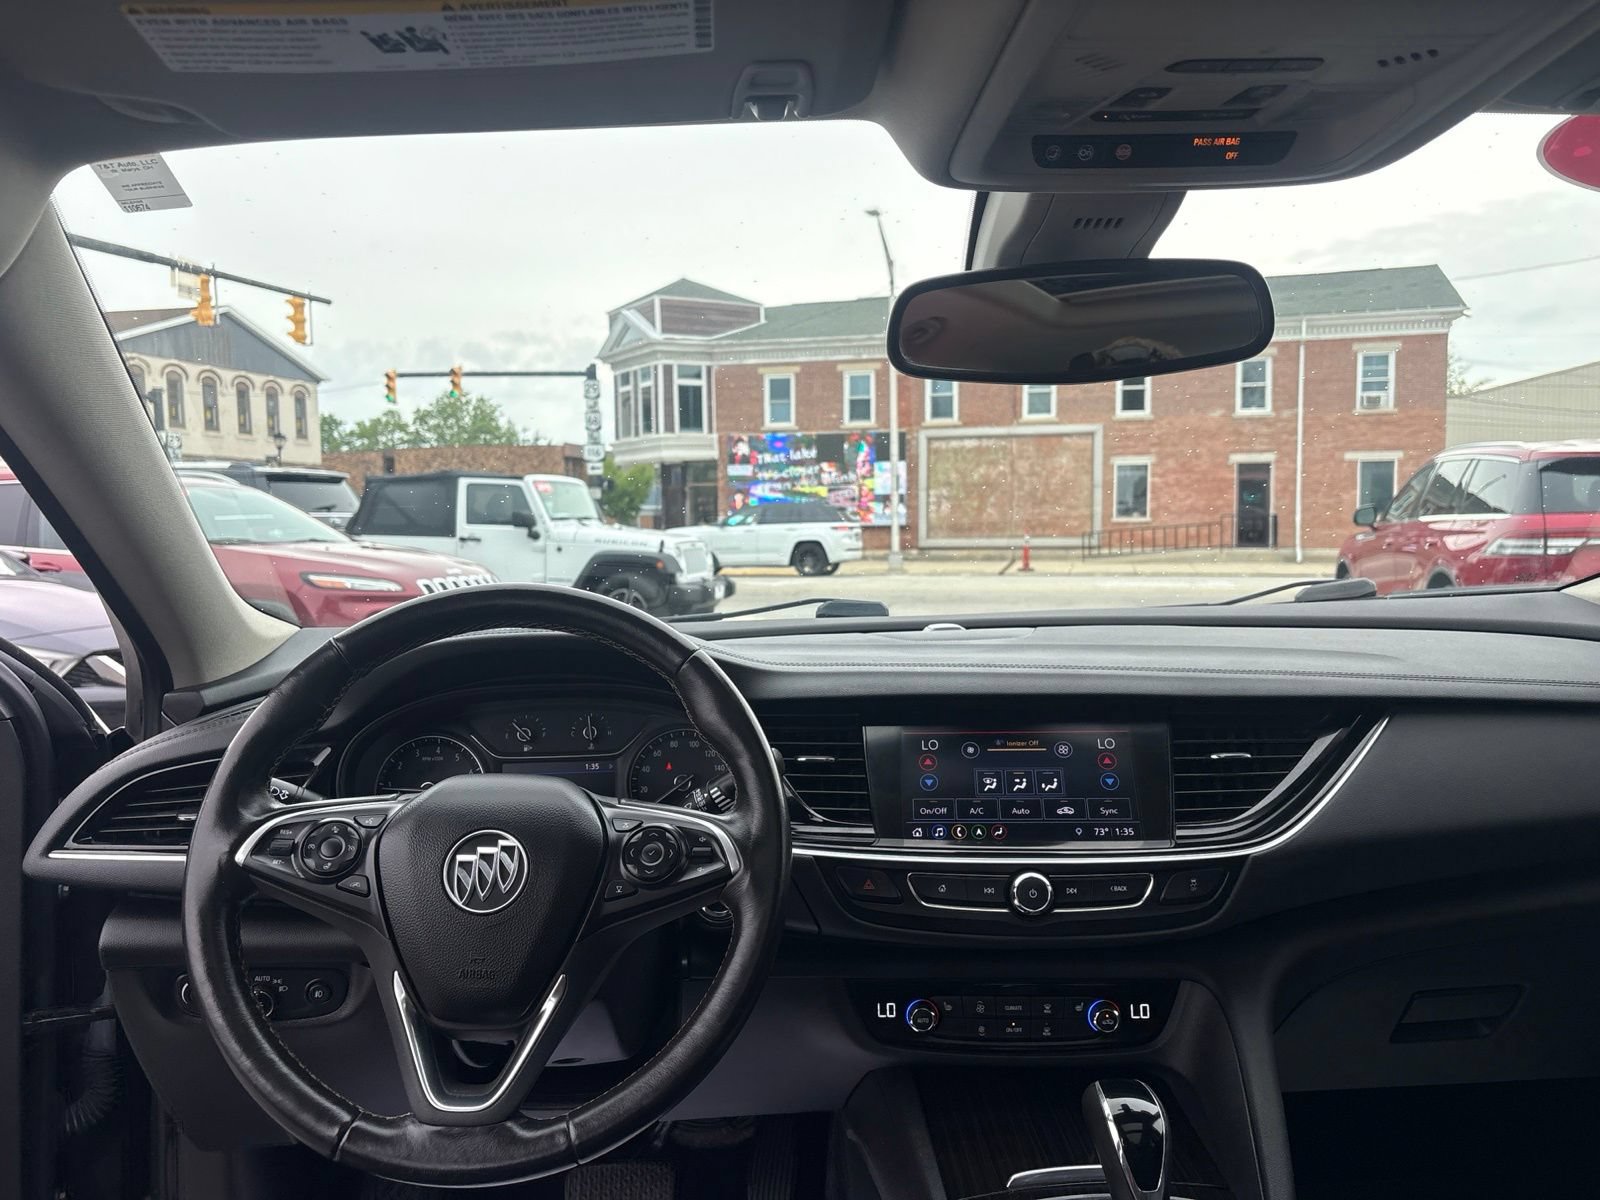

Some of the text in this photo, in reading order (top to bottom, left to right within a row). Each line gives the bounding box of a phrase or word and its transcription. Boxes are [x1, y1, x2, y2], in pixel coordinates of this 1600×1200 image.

[1193, 137, 1241, 146] PASS AIR BAG
[1225, 151, 1239, 160] OFF
[97, 162, 115, 170] T&T
[139, 158, 159, 166] LLC
[669, 740, 679, 748] 80
[689, 740, 700, 748] 100
[921, 739, 938, 751] LO
[1097, 738, 1115, 750] LO
[415, 749, 420, 758] 3
[435, 746, 441, 754] 4
[455, 753, 460, 762] 5
[642, 765, 651, 773] 40
[919, 807, 948, 816] On/Off
[969, 807, 984, 815] A/C
[1012, 807, 1030, 815] Auto
[1100, 807, 1119, 817] Sync
[1115, 827, 1134, 836] 1:35
[458, 968, 496, 980] AIRBAG
[877, 1002, 896, 1018] LO
[1130, 1003, 1150, 1019] LO
